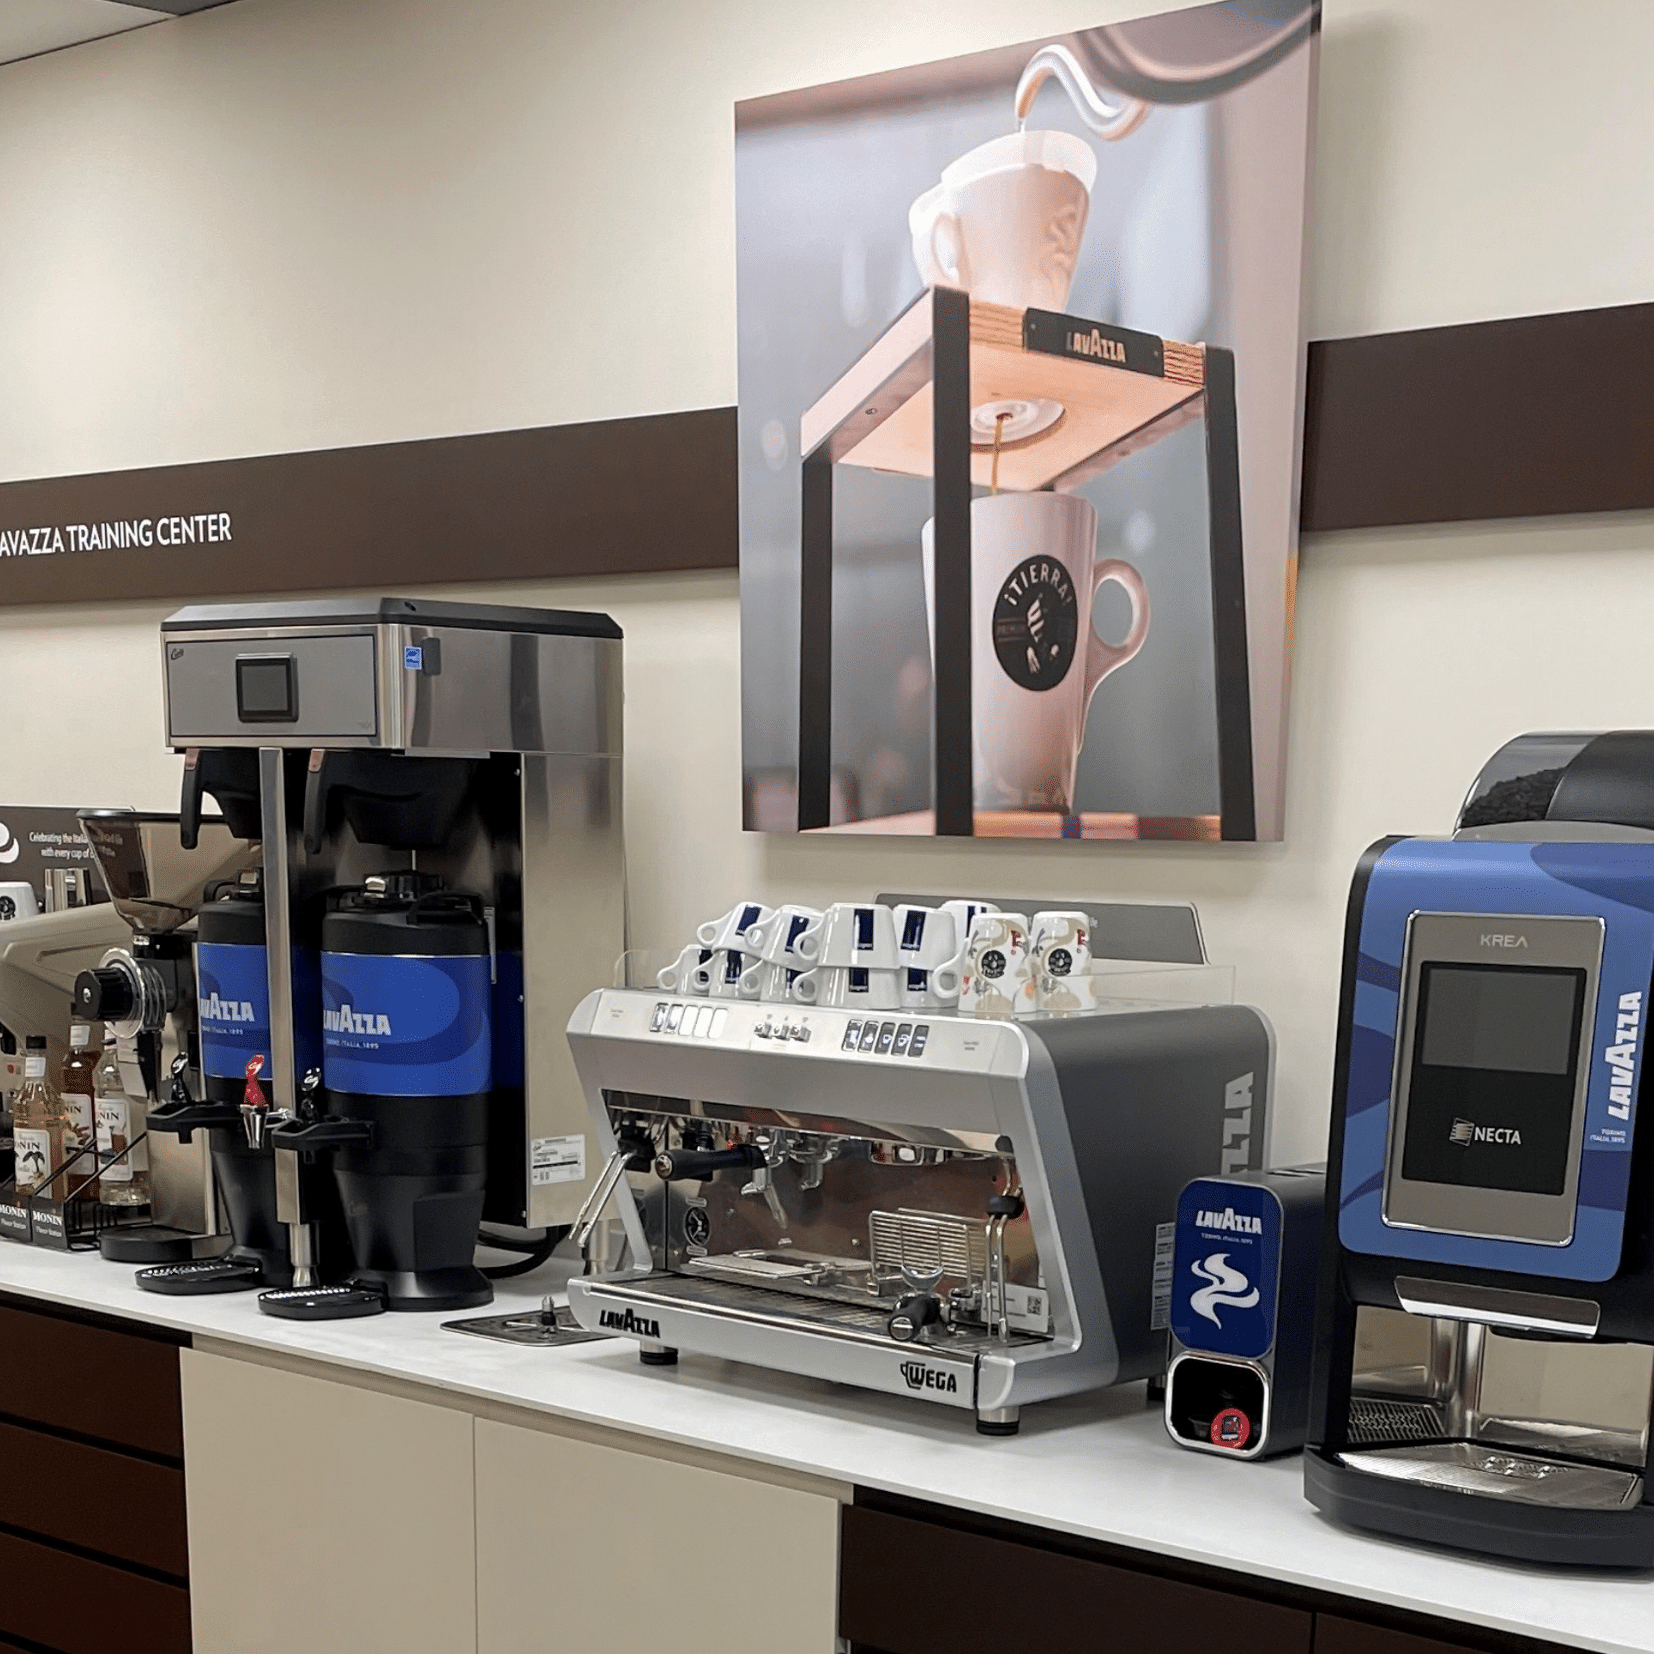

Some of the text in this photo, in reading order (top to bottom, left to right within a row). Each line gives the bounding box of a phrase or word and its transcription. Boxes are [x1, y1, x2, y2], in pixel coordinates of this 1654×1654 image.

[66, 519, 152, 552] TRAINING
[156, 512, 232, 546] CENTER
[29, 831, 62, 845] Celebrating
[63, 832, 72, 843] the
[73, 833, 89, 843] Italia
[41, 846, 54, 857] with
[55, 849, 70, 859] every
[71, 850, 82, 860] cup
[1480, 934, 1528, 948] KREA
[1604, 991, 1643, 1121] LAVAZZA
[1220, 1071, 1254, 1175] ZZA
[1474, 1126, 1522, 1145] NECTA
[33, 1210, 62, 1226] MONIN
[1195, 1207, 1263, 1235] LAVAZZA
[599, 1308, 661, 1339] LAVAZZA
[907, 1364, 957, 1393] WEGA
